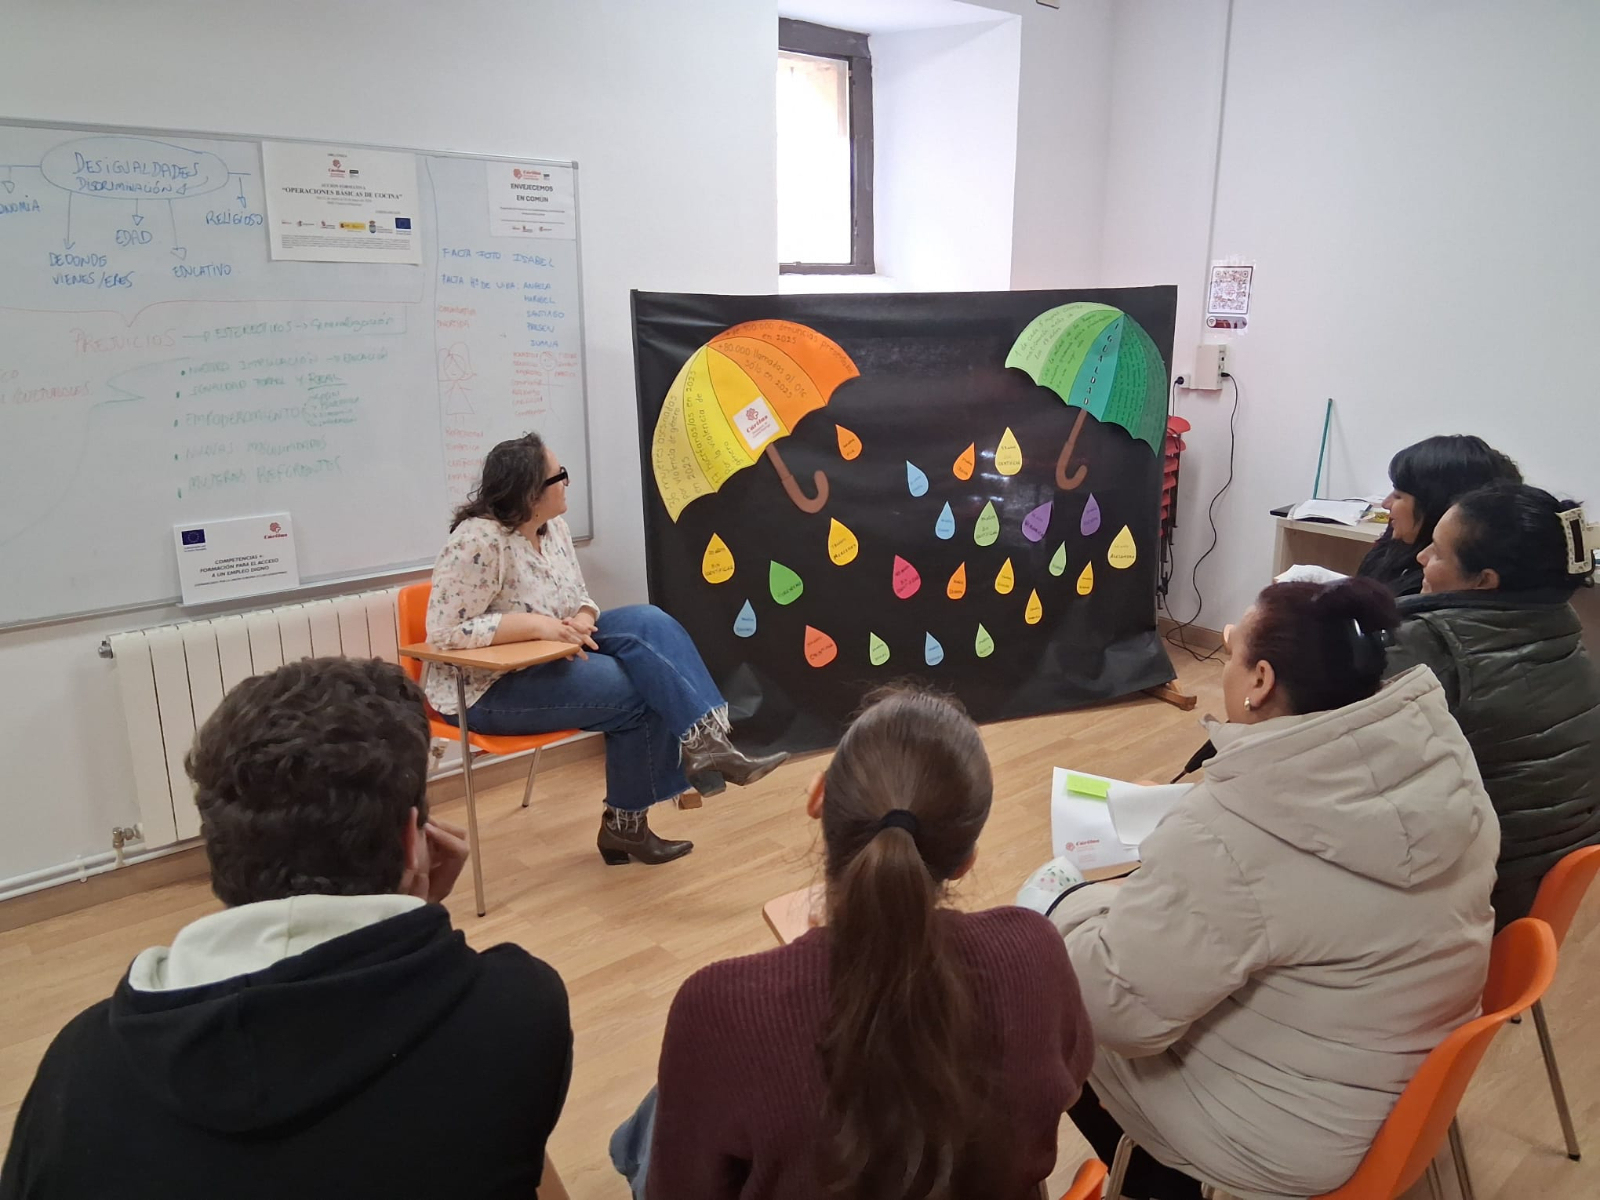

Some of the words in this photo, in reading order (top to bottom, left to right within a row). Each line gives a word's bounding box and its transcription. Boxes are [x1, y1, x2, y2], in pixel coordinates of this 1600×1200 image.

[510, 183, 553, 192] ENVEJECEMOS
[516, 194, 525, 202] EN
[115, 229, 152, 247] EDAD
[214, 554, 258, 565] COMPETENCIAS
[226, 568, 250, 576] EMPLEO
